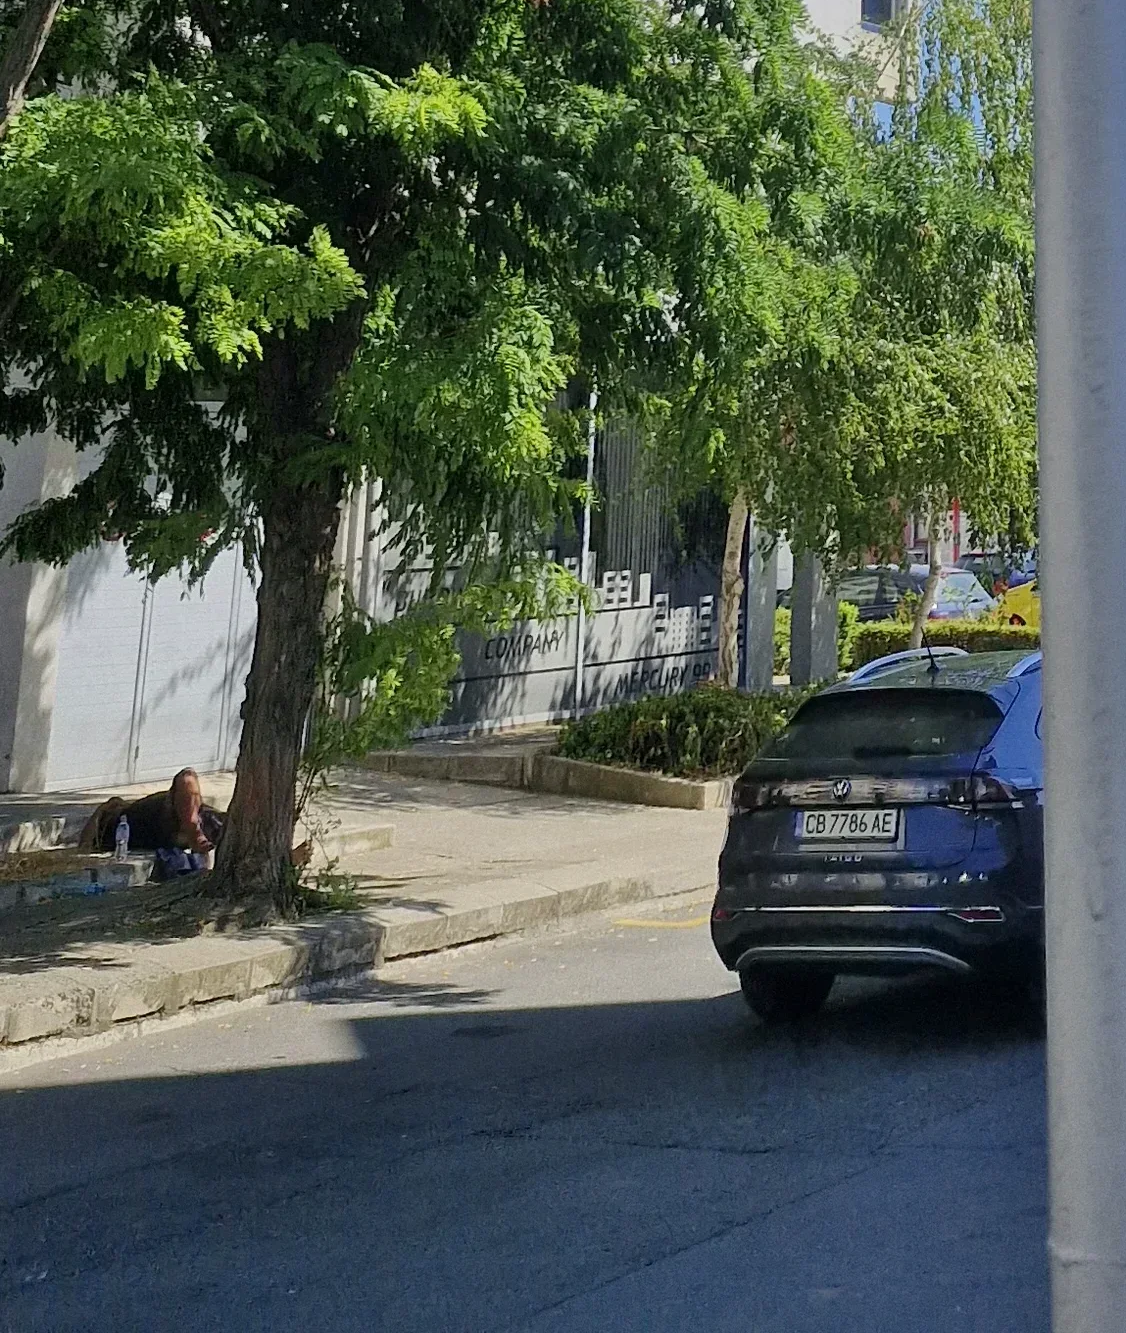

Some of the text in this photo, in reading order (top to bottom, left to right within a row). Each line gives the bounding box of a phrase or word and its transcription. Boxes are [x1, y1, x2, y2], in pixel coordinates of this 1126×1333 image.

[484, 630, 565, 660] COMPANY
[612, 663, 688, 697] MERCURY
[829, 813, 868, 833] 7786
